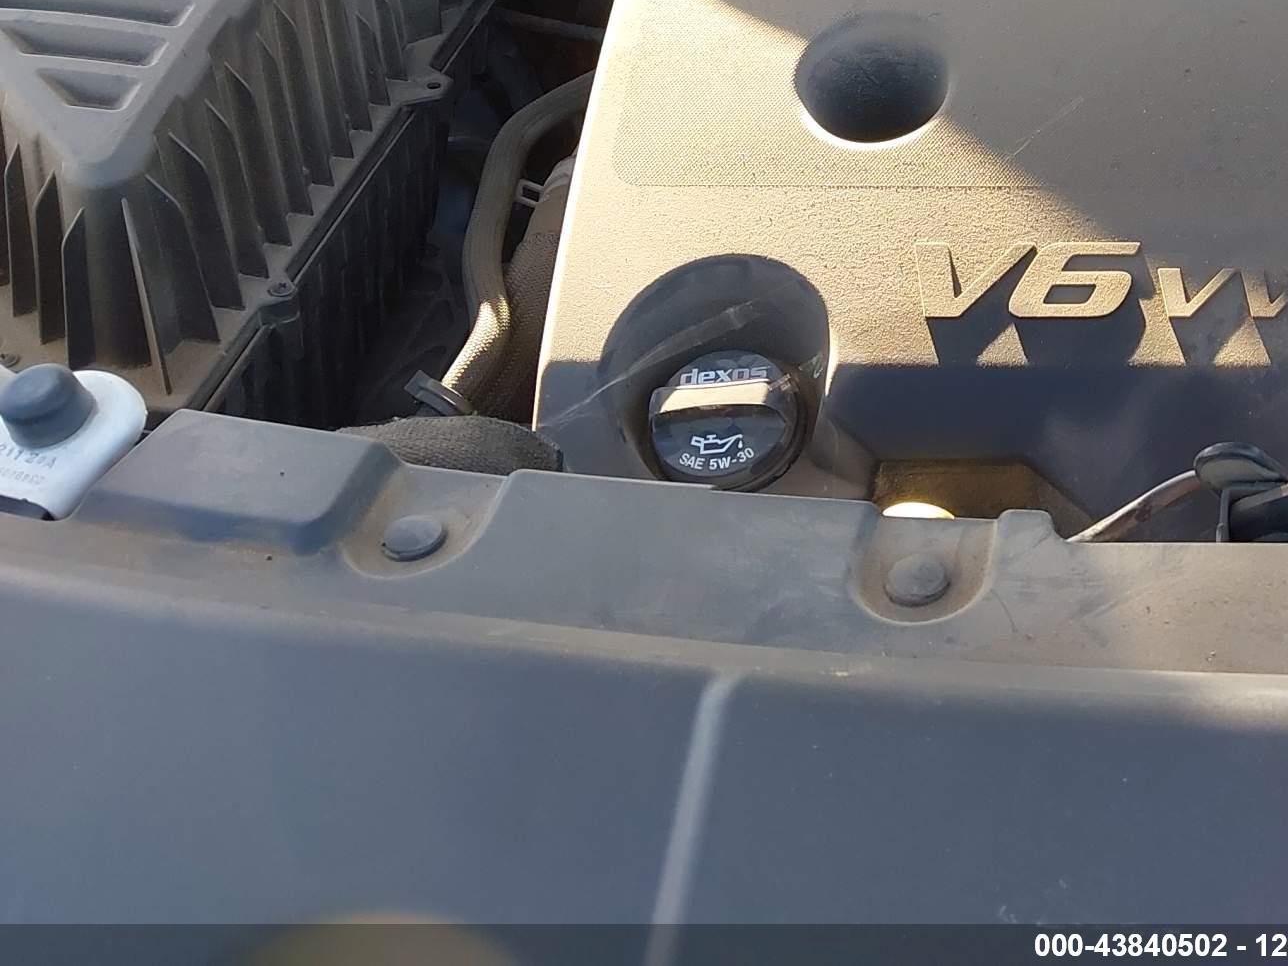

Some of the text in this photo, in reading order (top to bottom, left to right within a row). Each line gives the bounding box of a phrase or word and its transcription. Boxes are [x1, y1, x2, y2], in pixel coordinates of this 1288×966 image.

[914, 241, 1141, 318] V6
[680, 364, 771, 386] dexos
[679, 447, 755, 471] SAE 5W-30
